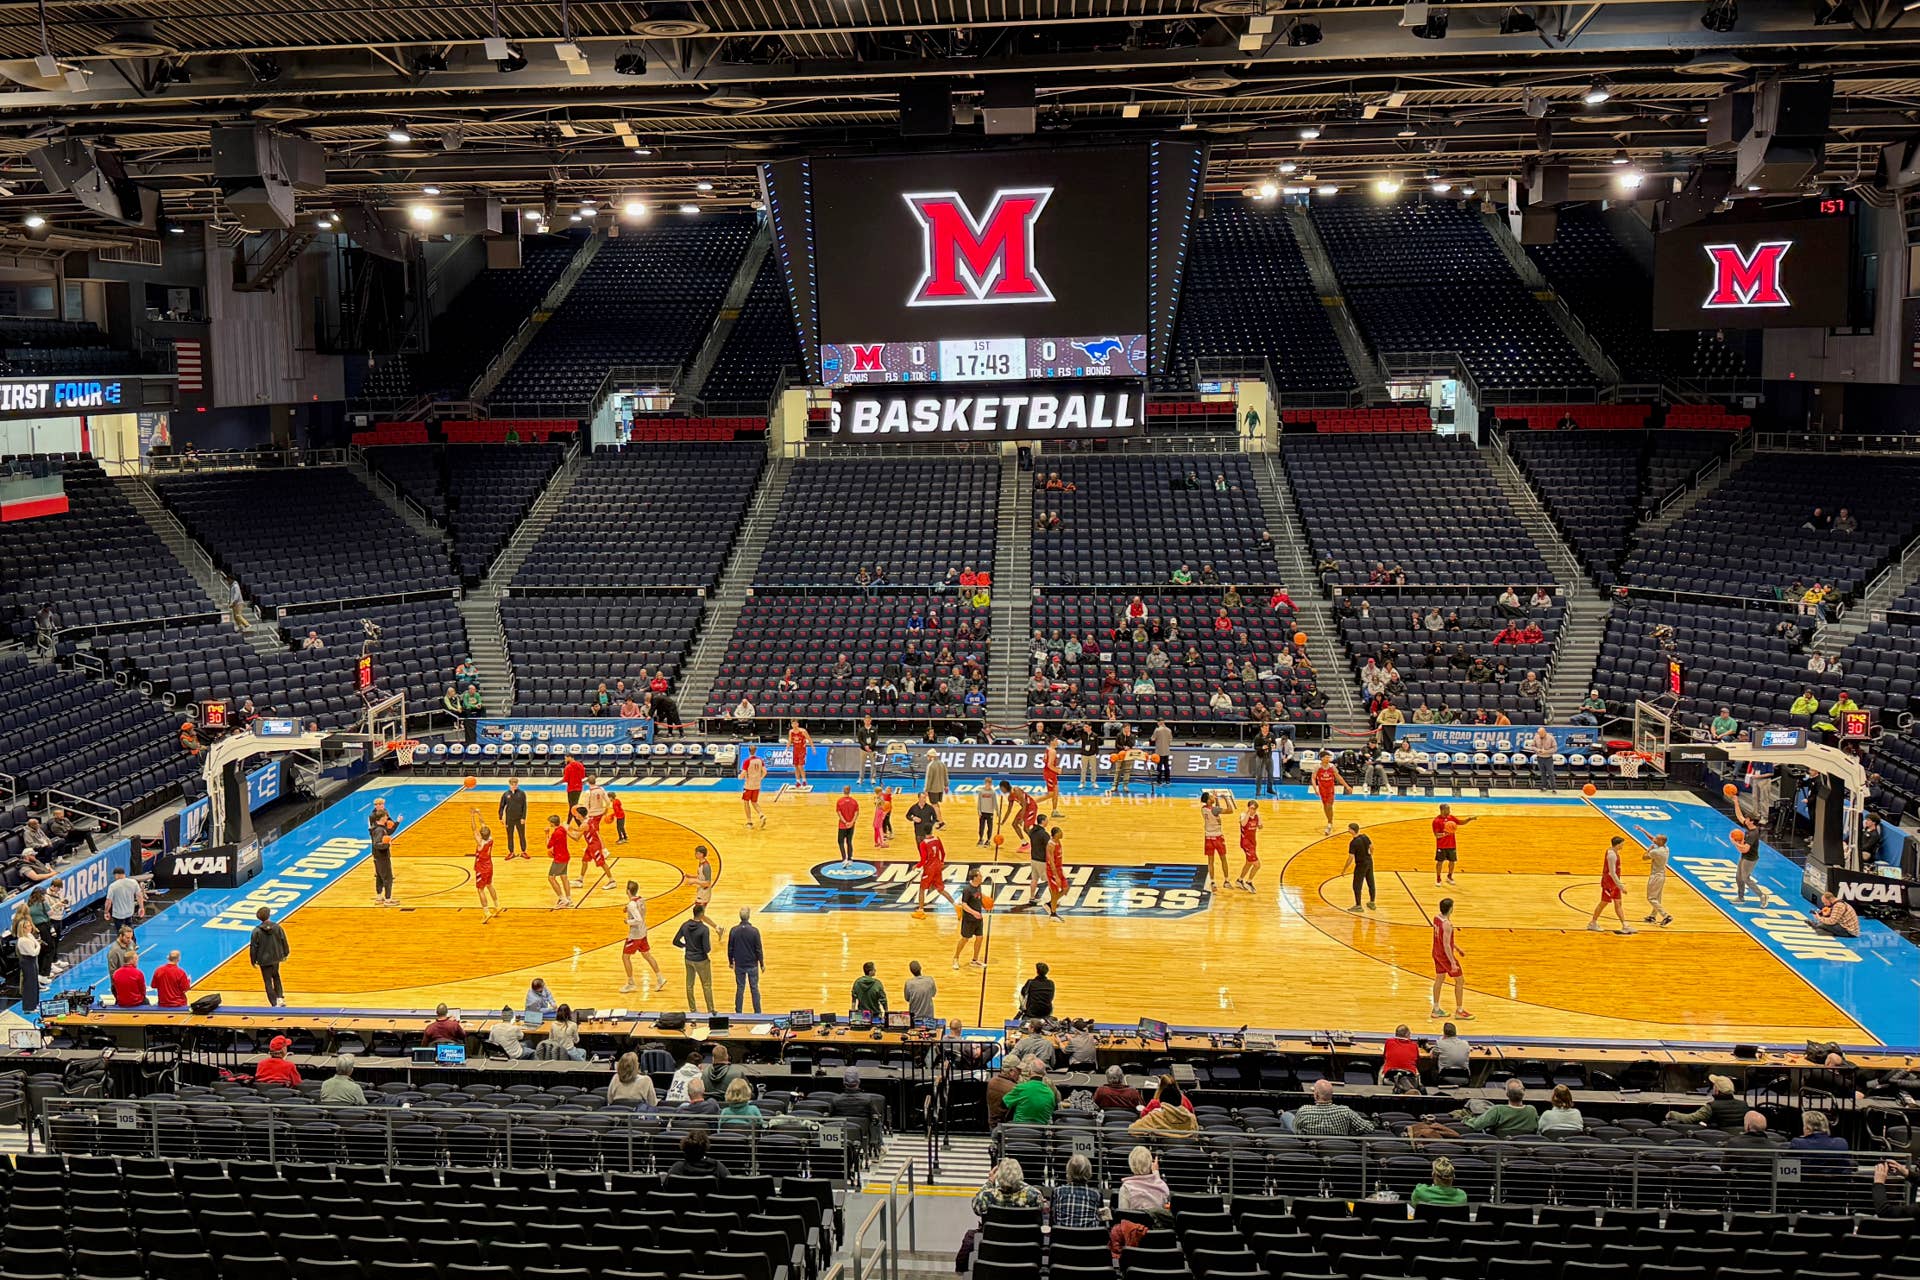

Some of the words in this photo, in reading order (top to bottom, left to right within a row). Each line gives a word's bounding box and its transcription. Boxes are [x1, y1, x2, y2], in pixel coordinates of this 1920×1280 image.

[902, 186, 1056, 307] M
[1702, 241, 1793, 309] M
[973, 341, 991, 352] 1ST
[1043, 341, 1057, 361] 0
[848, 343, 886, 373] M
[912, 346, 925, 365] 0
[955, 354, 1010, 376] 17:43
[1058, 366, 1071, 377] FLS
[1085, 365, 1111, 377] BONUS
[844, 372, 869, 383] BONUS
[885, 372, 898, 382] FLS
[1029, 367, 1044, 378] TOL
[55, 381, 103, 408] FOUR
[851, 393, 1134, 434] BASKETBALL
[208, 713, 221, 723] 30
[545, 724, 579, 738] FINAL
[581, 724, 615, 738] FOUR
[1432, 730, 1447, 740] THE
[1449, 730, 1472, 740] ROAD
[1848, 723, 1863, 734] 30
[935, 752, 966, 768] HE
[972, 752, 1028, 769] ROAD
[279, 836, 373, 879] FOUR
[173, 855, 230, 875] NCAA
[826, 868, 876, 878] NCAA
[1837, 881, 1906, 903] NCAA
[1734, 906, 1864, 963] FOUR
[118, 1114, 135, 1124] 105
[822, 1133, 839, 1142] 105
[1074, 1142, 1092, 1151] 104
[1780, 1166, 1797, 1175] 104
